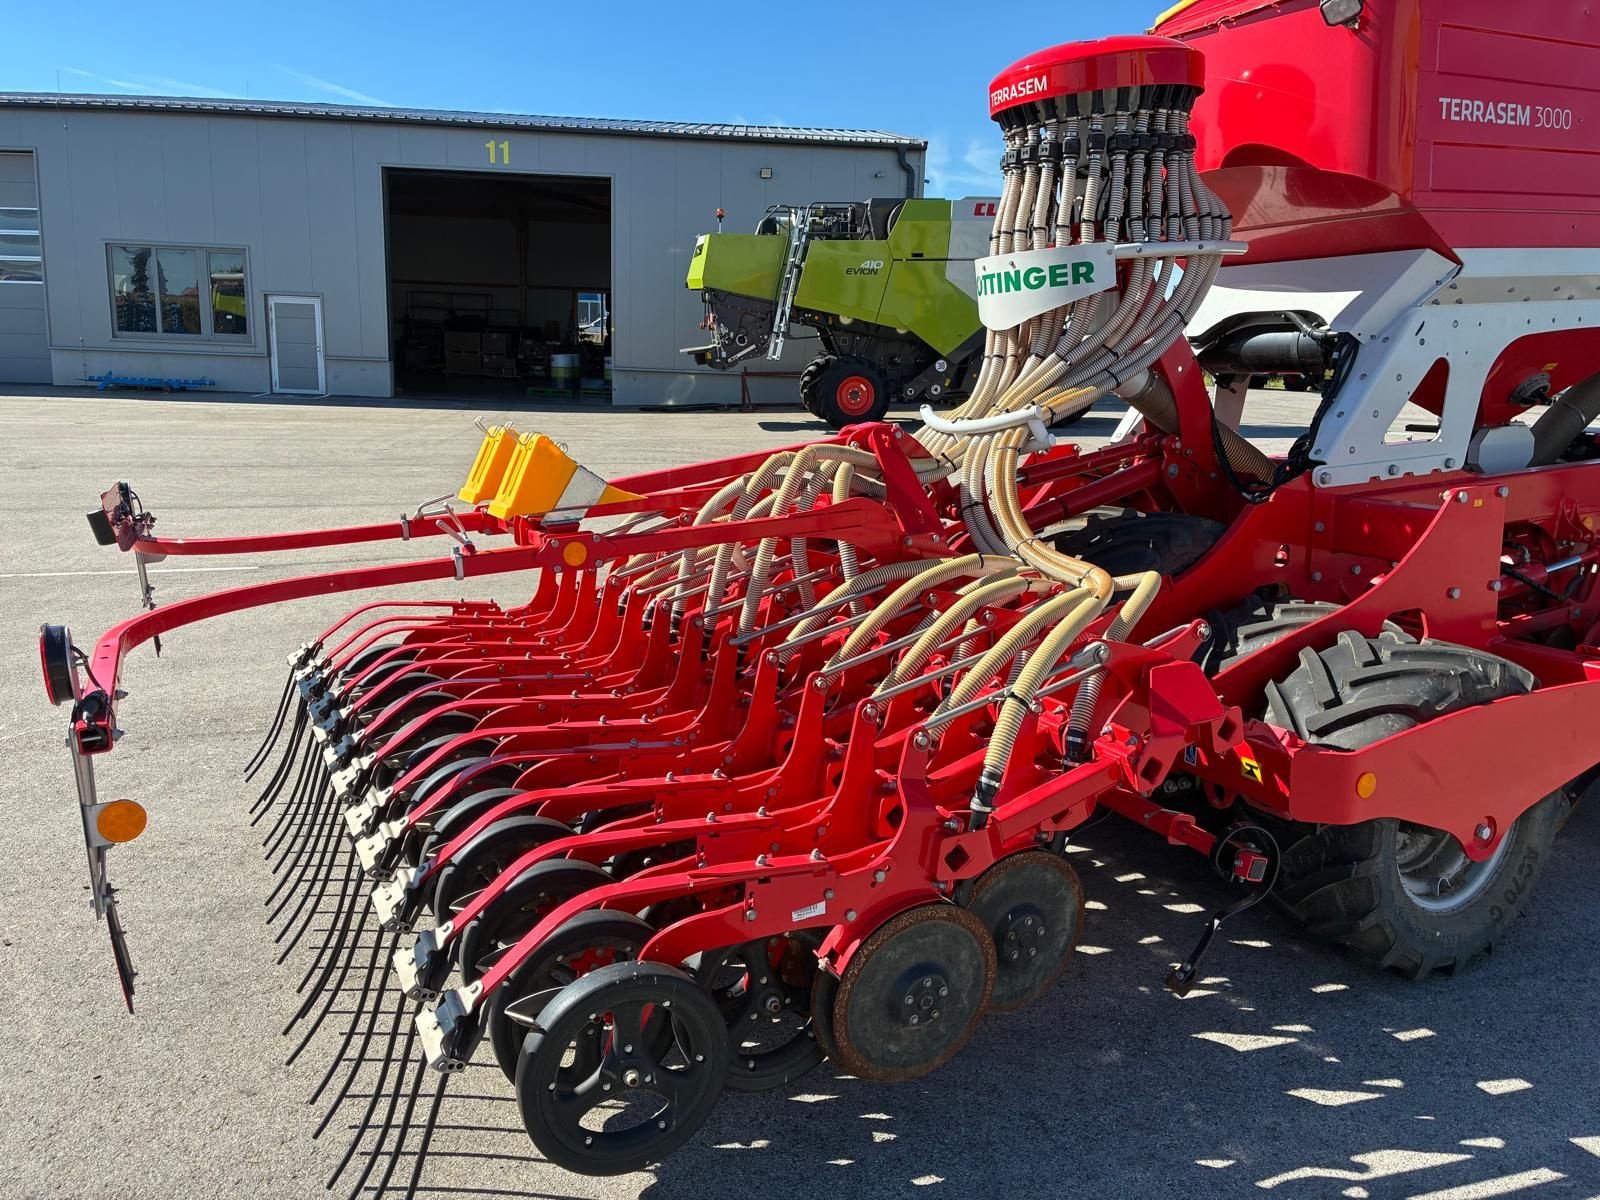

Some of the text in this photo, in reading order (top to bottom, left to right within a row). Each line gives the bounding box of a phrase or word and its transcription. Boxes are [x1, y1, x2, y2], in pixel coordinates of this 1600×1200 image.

[990, 74, 1048, 108] TERRASEM
[1438, 97, 1572, 130] TERRASEM 3000
[485, 140, 509, 165] 11
[846, 267, 879, 276] EVION
[860, 260, 884, 269] 410
